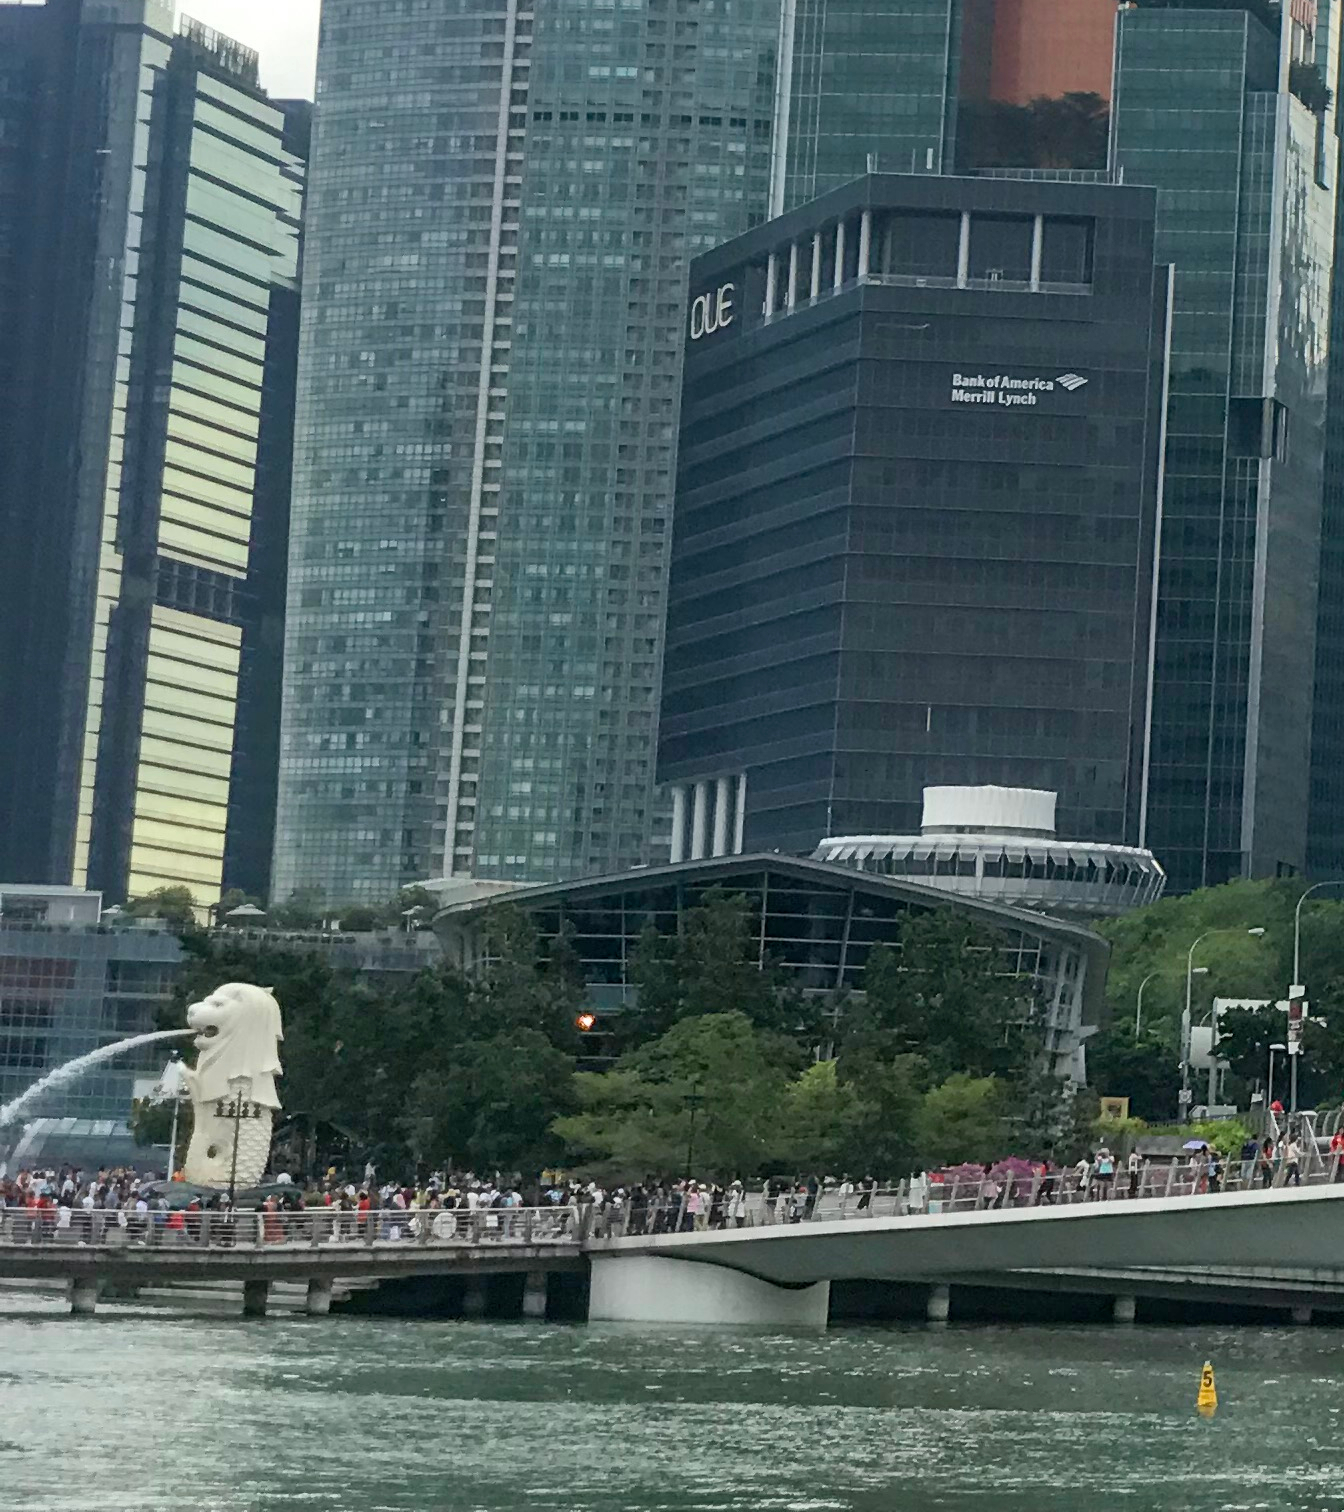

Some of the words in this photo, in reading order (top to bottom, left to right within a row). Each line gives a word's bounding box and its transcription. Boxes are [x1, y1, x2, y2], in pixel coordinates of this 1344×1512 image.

[691, 283, 735, 339] OUE
[952, 373, 985, 387] Bank
[986, 375, 1001, 388] of
[1000, 376, 1054, 391] America
[951, 389, 995, 403] Merrill
[998, 391, 1037, 406] Lynch
